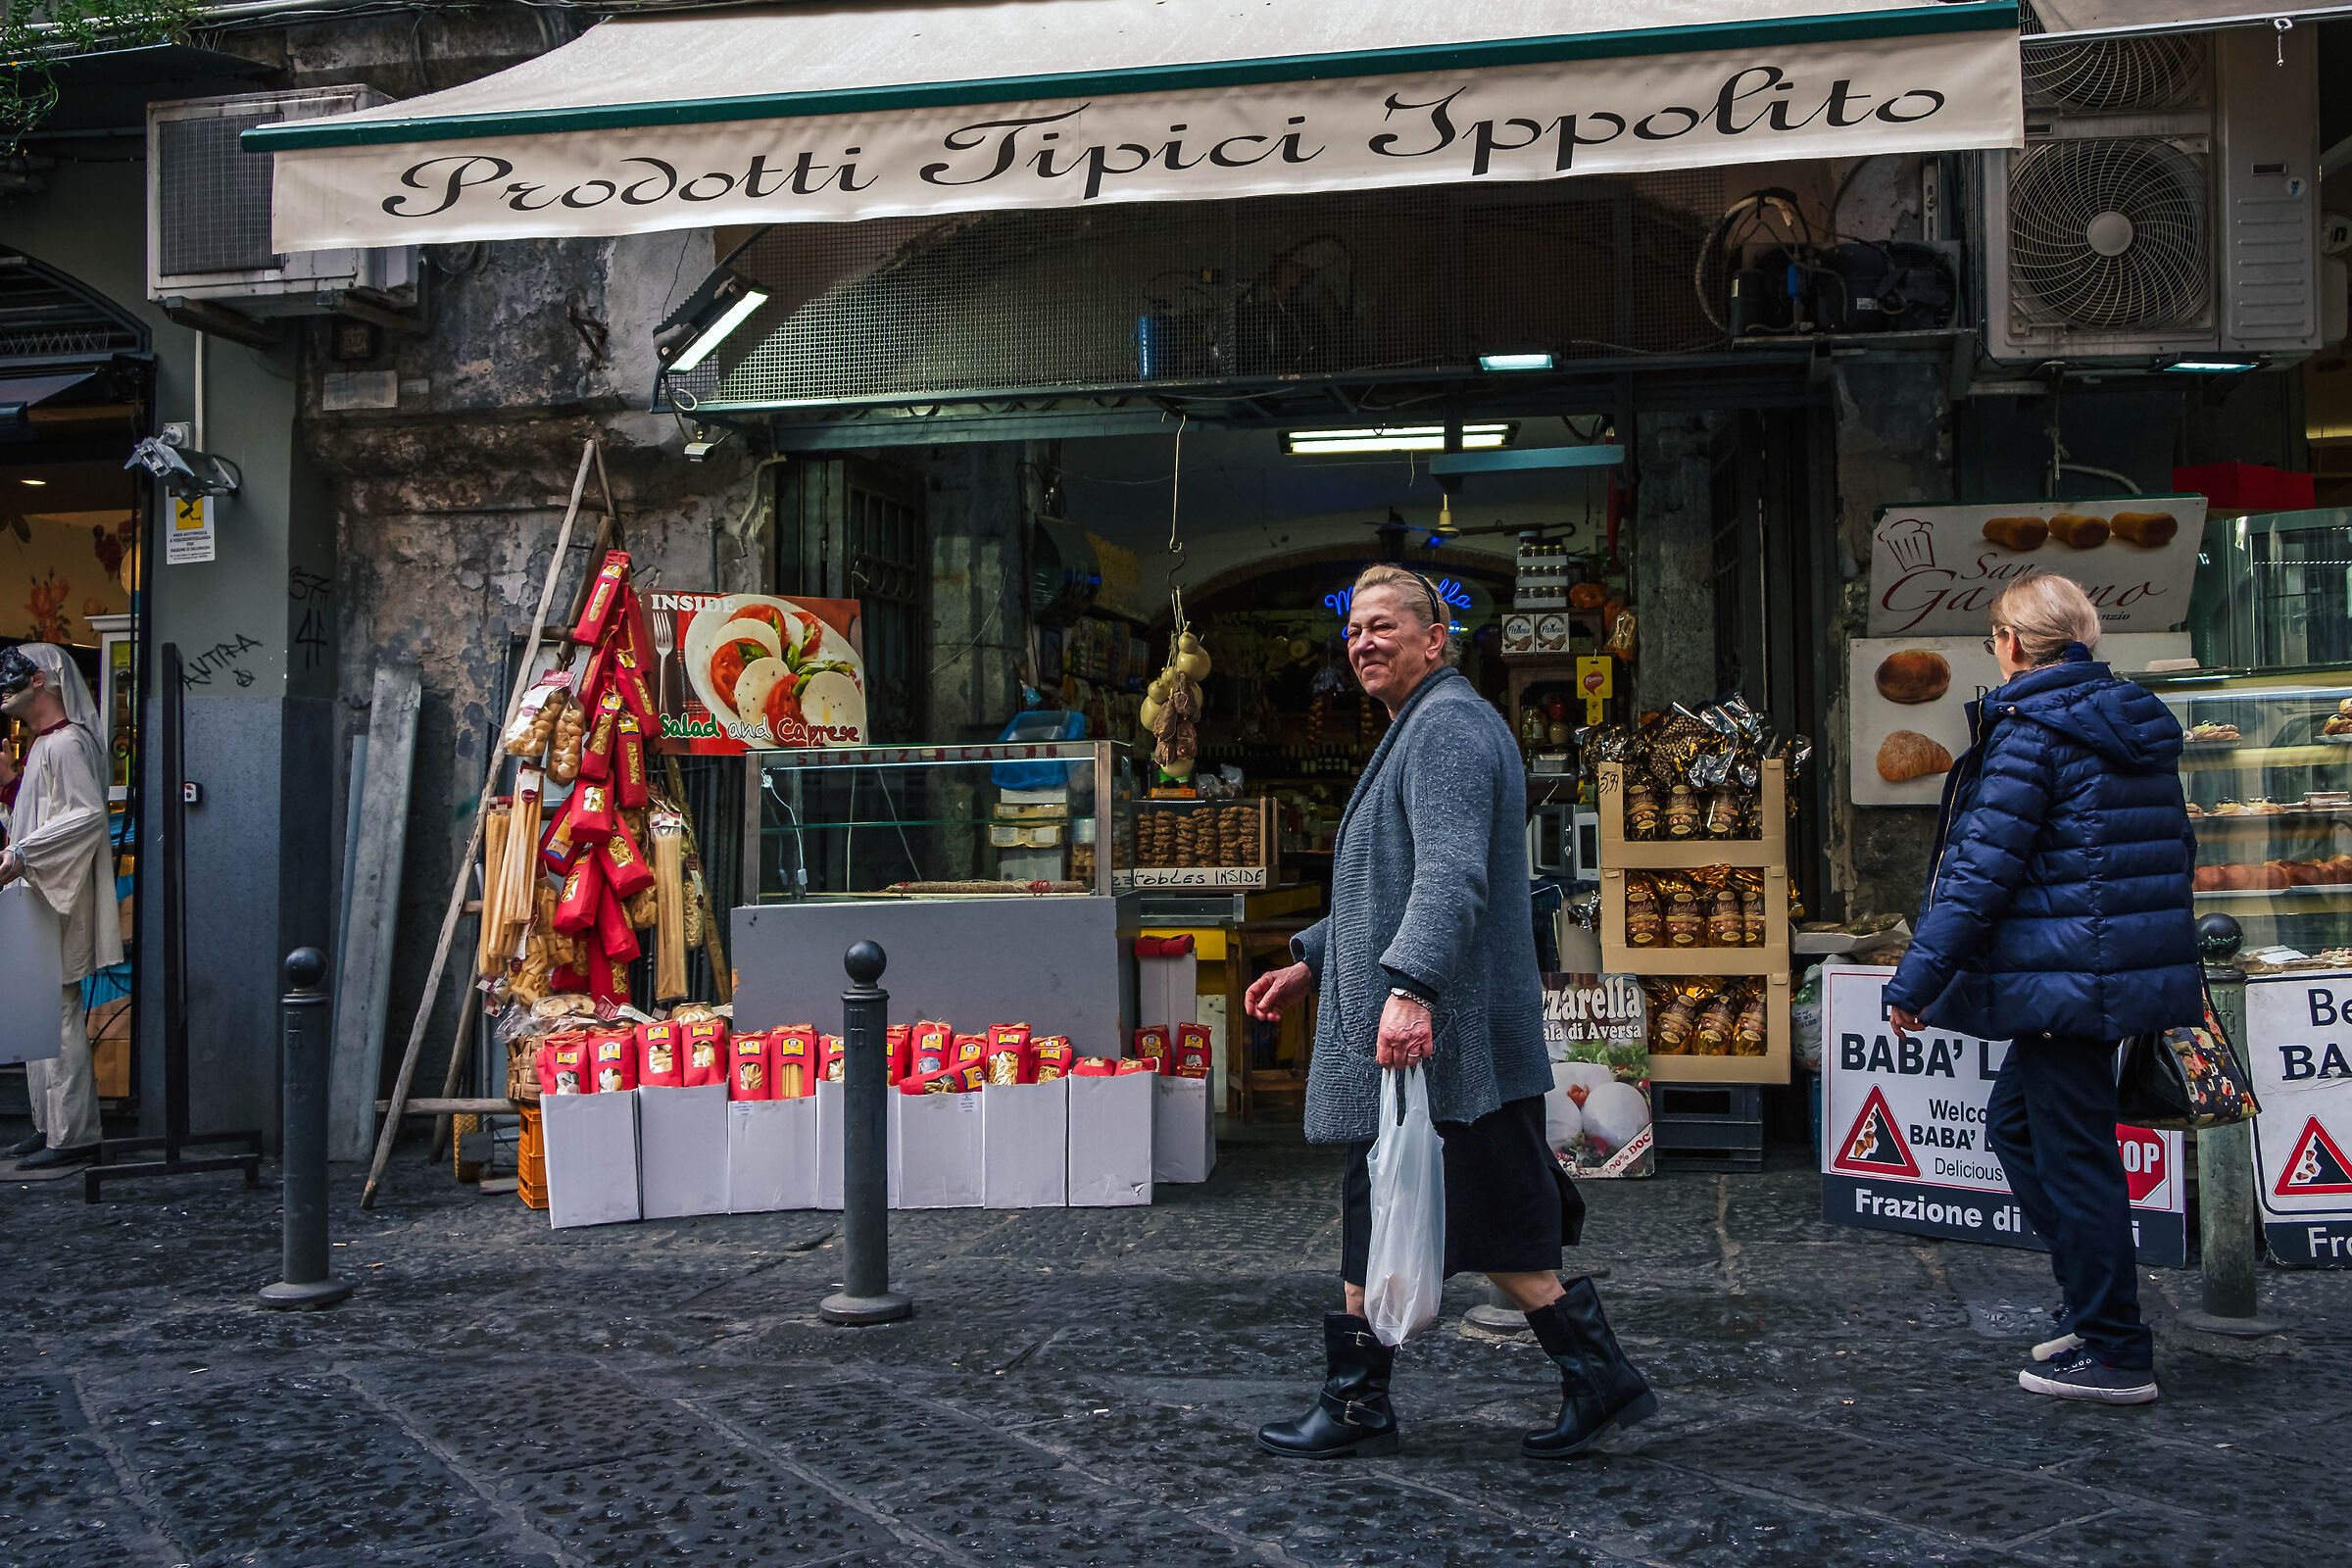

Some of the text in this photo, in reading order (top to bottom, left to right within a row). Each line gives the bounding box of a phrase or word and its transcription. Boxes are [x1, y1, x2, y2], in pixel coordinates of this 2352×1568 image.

[381, 66, 1945, 218] Prodotti Tipici Ippolito
[1961, 552, 2034, 580] San
[651, 594, 737, 612] INSIDE
[1881, 568, 2168, 634] Gano
[2097, 610, 2131, 621] nzio
[659, 712, 860, 748] Salad and Caprese
[1215, 868, 1264, 885] INSIDE
[1543, 976, 1642, 1021] zarella
[1544, 1022, 1642, 1041] ala di Aversa
[1980, 1041, 2001, 1081] L
[2278, 1043, 2352, 1081] BA
[1929, 1099, 1987, 1124] Welco
[1627, 1133, 1651, 1154] DOC
[2118, 1140, 2160, 1174] OP
[1935, 1157, 2003, 1182] Delicious
[1855, 1188, 2021, 1233] Frazione di
